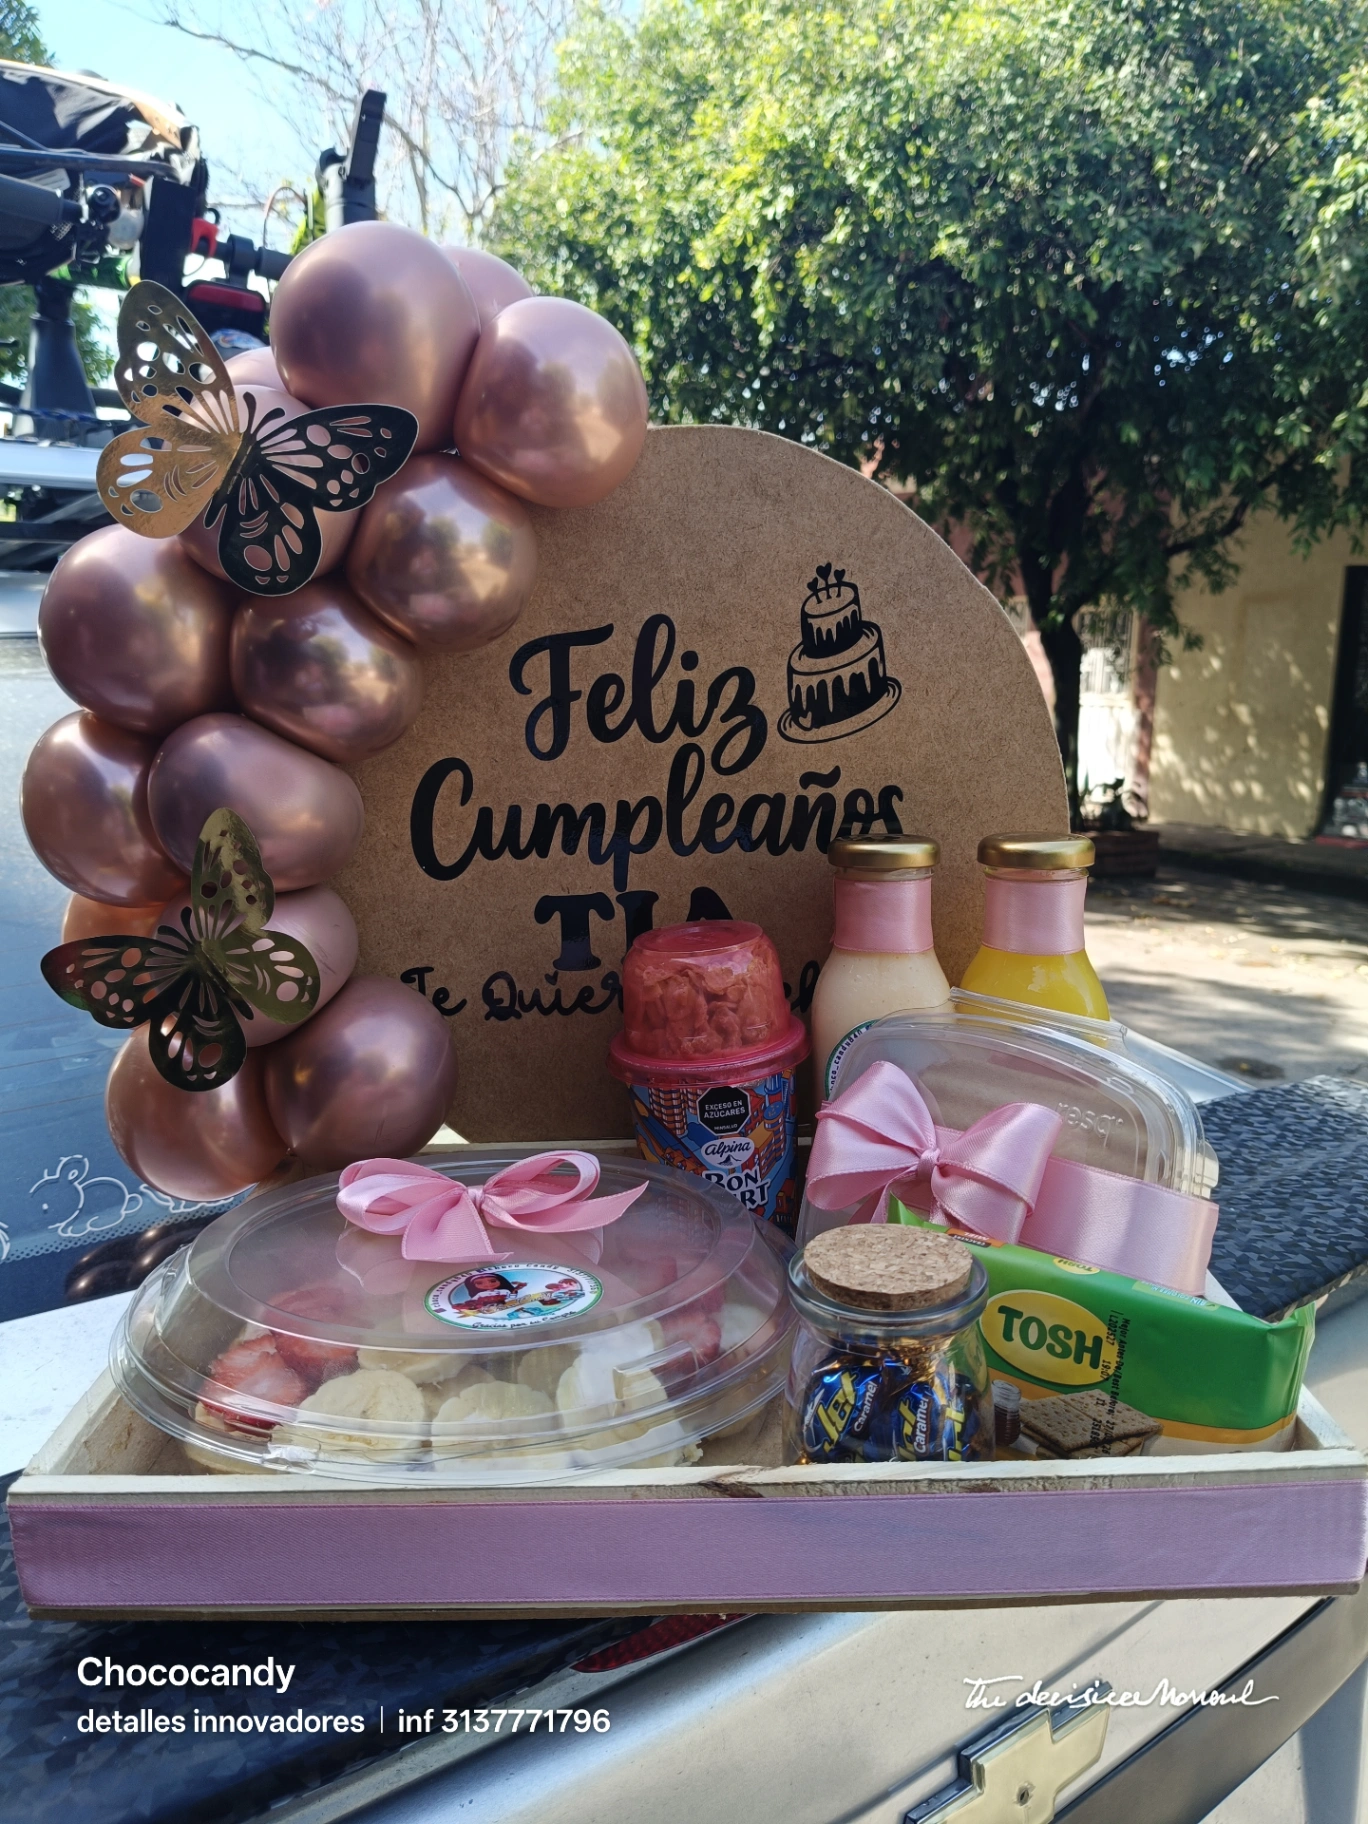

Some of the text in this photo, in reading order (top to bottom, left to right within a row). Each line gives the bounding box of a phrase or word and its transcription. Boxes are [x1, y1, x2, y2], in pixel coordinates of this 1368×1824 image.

[509, 613, 768, 776] Feliz
[410, 743, 904, 893] Cumpleaños
[482, 970, 624, 1021] Quier
[705, 1101, 732, 1111] EXCESO
[997, 1304, 1103, 1370] TOSH
[1116, 1338, 1127, 1359] Antes
[1118, 1317, 1131, 1338] Mejor
[853, 1381, 879, 1432] Caramel
[912, 1396, 929, 1453] Caramel
